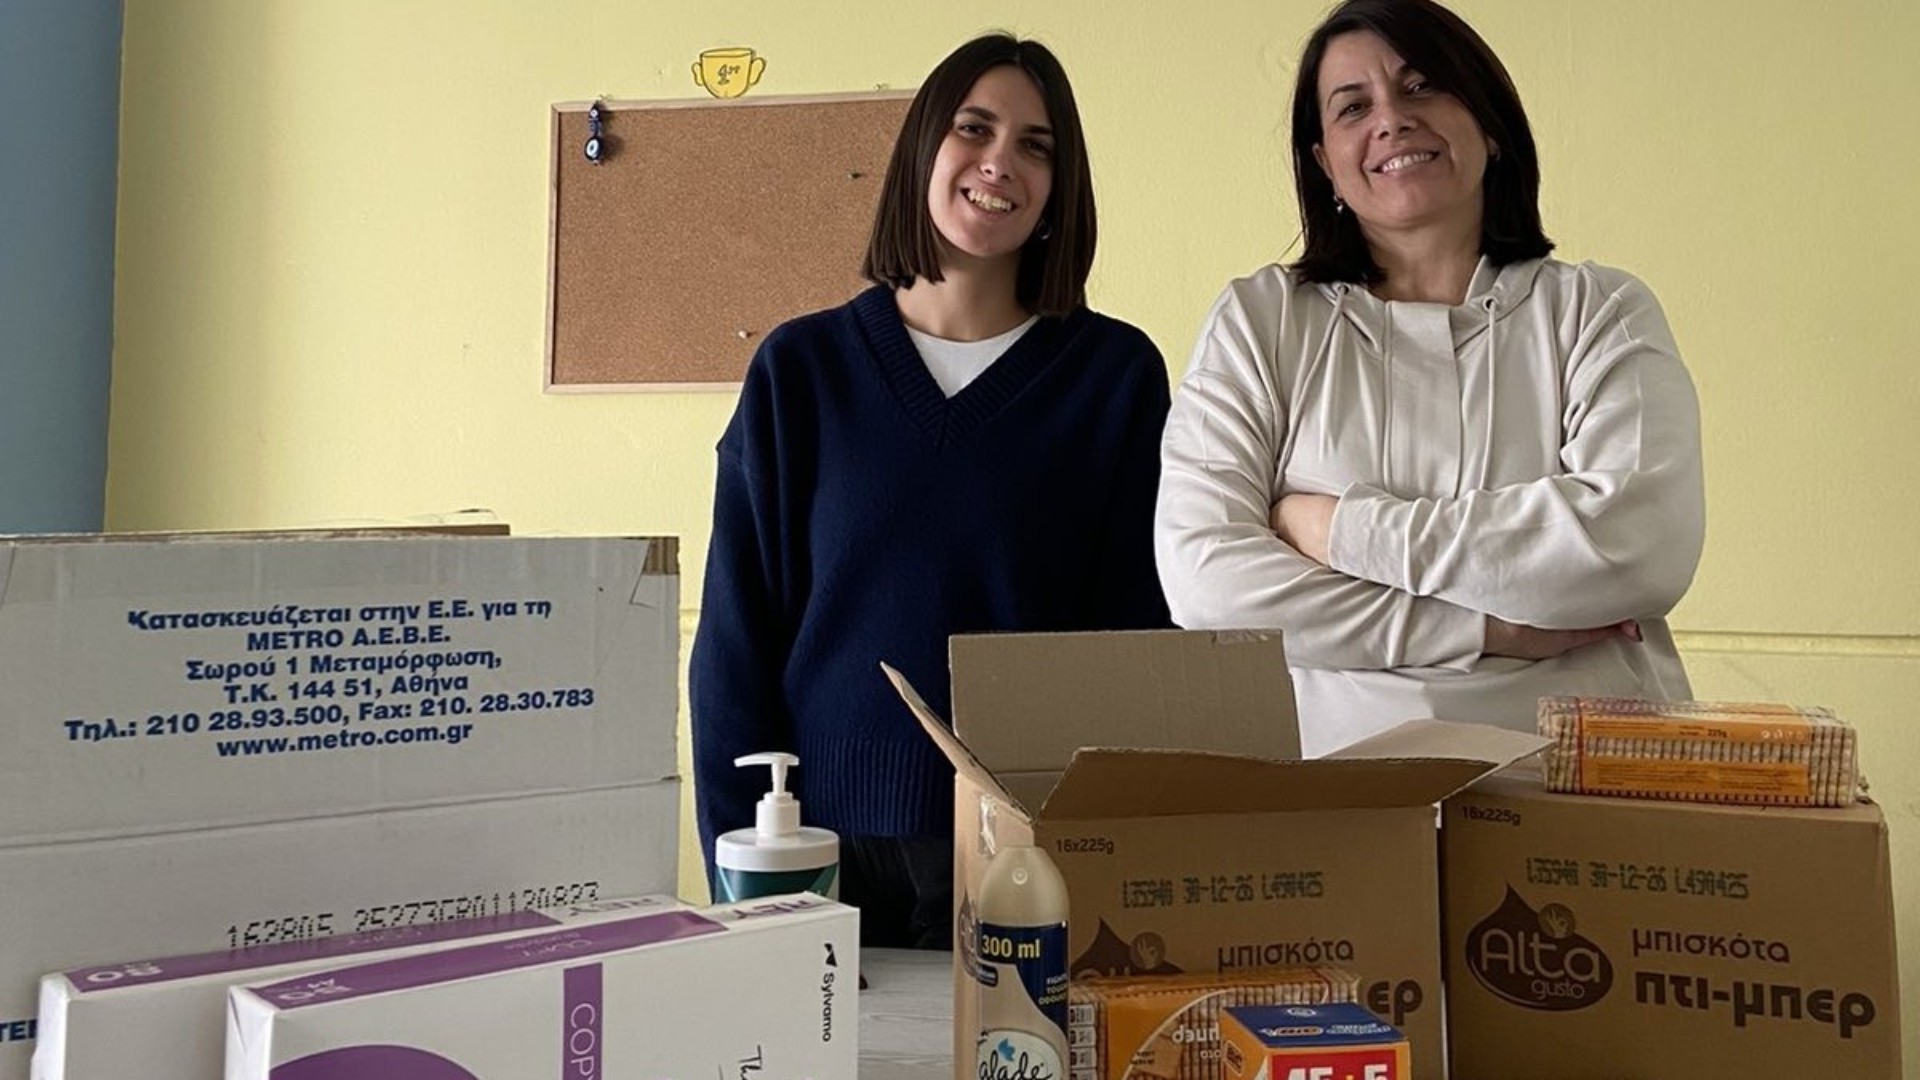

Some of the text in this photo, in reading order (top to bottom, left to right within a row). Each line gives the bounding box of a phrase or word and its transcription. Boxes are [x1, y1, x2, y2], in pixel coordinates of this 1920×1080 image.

[128, 600, 551, 630] Κατασκευάζεται στην Ε.Ε. για τη
[247, 625, 451, 651] METRO Α.Ε.Β.Ε.
[186, 650, 501, 683] Σωρού 1 Μεταμόρφωση,
[224, 672, 468, 704] Τ.Κ. 144 51, Αθήνα
[64, 688, 594, 742] Τηλ.: 210 28.93.500, Fax: 210. 28.30.783
[217, 724, 473, 757] www.metro.com.gr
[1463, 806, 1521, 827] 16x225g
[1056, 837, 1114, 855] 16x225g
[981, 935, 1041, 958] 300 ml
[1218, 937, 1354, 972] μπισκότα
[1480, 928, 1601, 983] Alta
[1632, 928, 1790, 963] μπισκότα
[1531, 978, 1585, 1000] gusto
[1635, 971, 1876, 1038] πτι-μπερ
[820, 972, 835, 1042] Sylvamo
